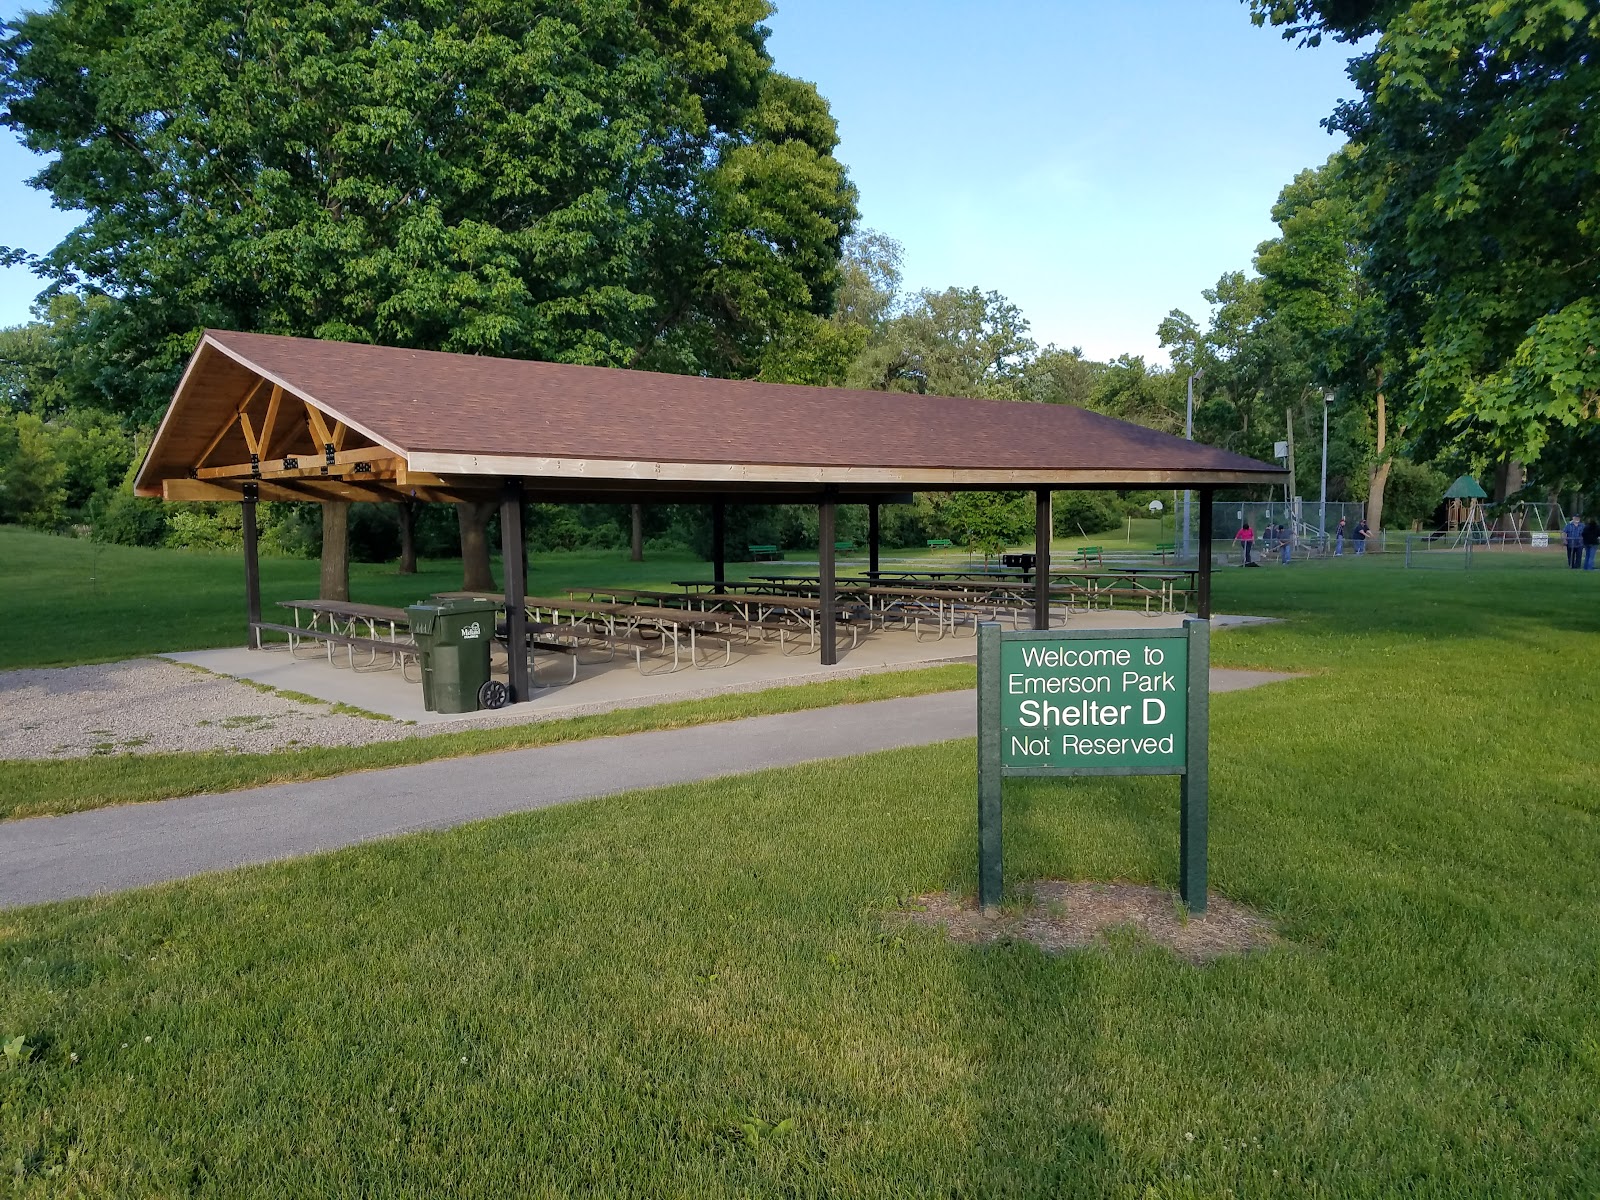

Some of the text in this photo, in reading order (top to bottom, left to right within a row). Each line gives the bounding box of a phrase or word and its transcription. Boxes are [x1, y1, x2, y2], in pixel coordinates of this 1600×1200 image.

[1021, 645, 1164, 668] Welcome to
[1008, 671, 1176, 694] Emerson Park
[1019, 698, 1166, 727] Shelter D
[1011, 733, 1174, 756] Not Reserved
